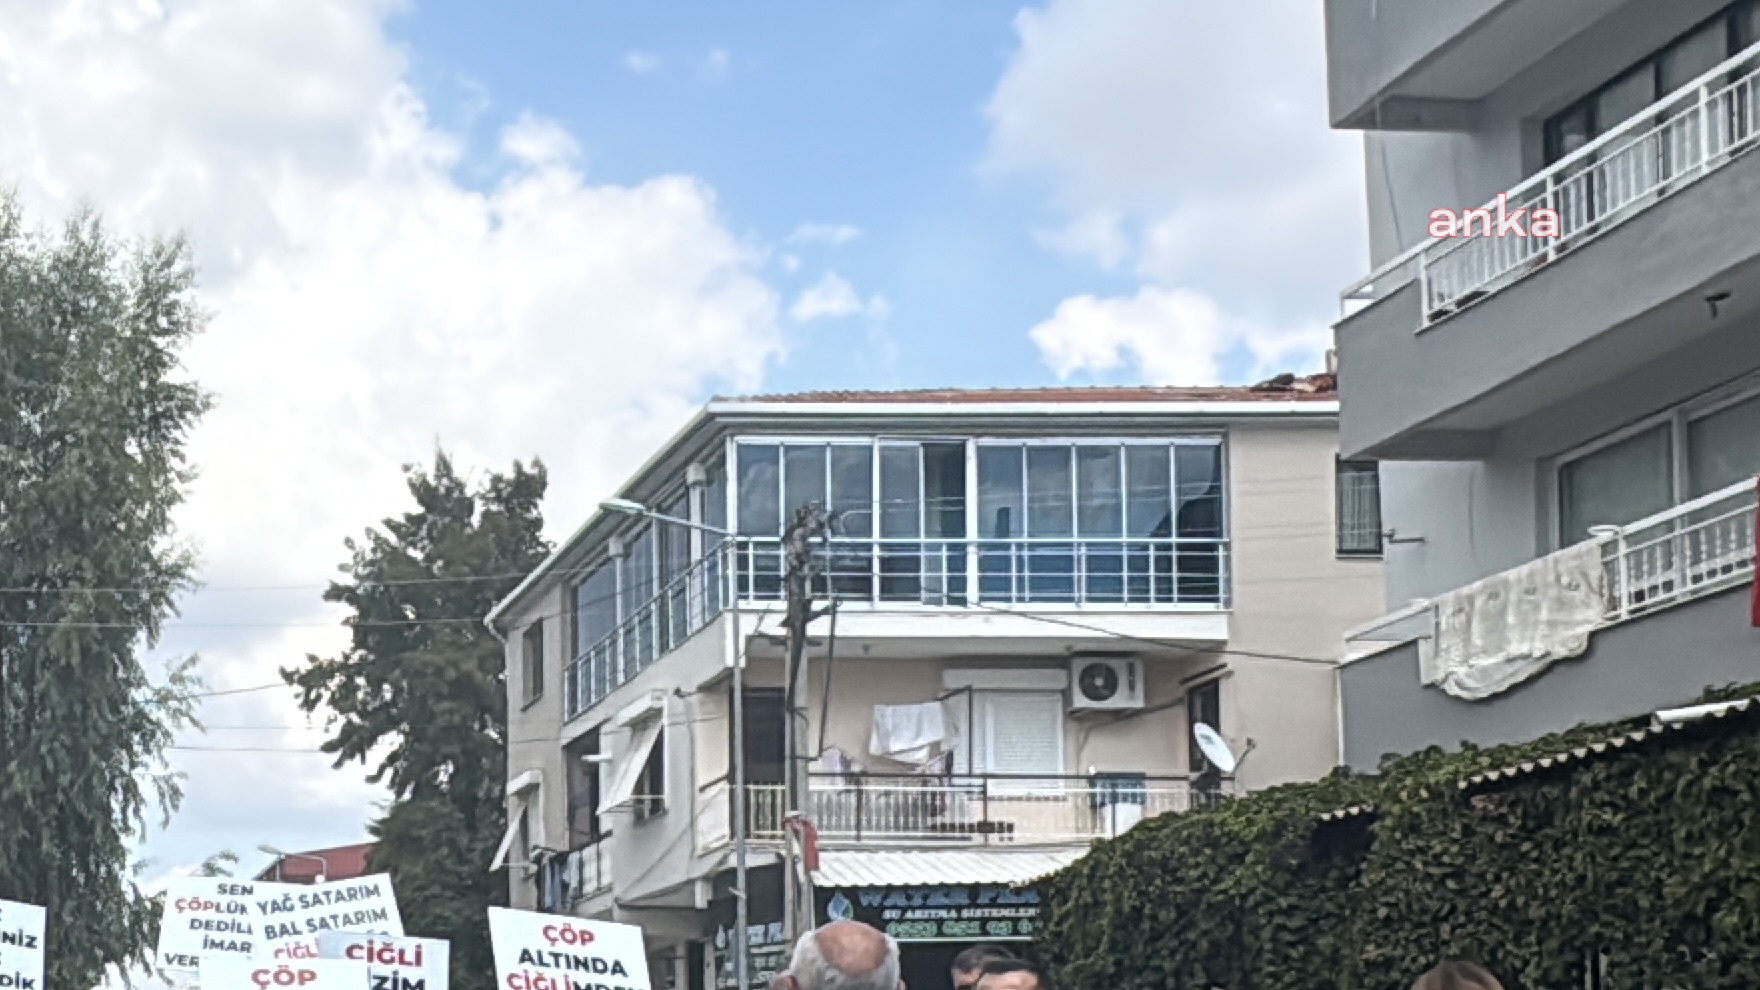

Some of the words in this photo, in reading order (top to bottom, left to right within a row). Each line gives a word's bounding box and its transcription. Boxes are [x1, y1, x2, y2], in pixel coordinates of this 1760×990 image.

[217, 883, 254, 896] SEN
[257, 893, 296, 916] YAĞ
[298, 883, 382, 909] SATARIM
[264, 921, 303, 940] BAL
[305, 907, 389, 933] SATARIM
[542, 922, 596, 947] ÇÖP
[203, 934, 252, 953] İMAR
[518, 946, 629, 978] ALTINDA
[251, 964, 318, 990] ÇÖP
